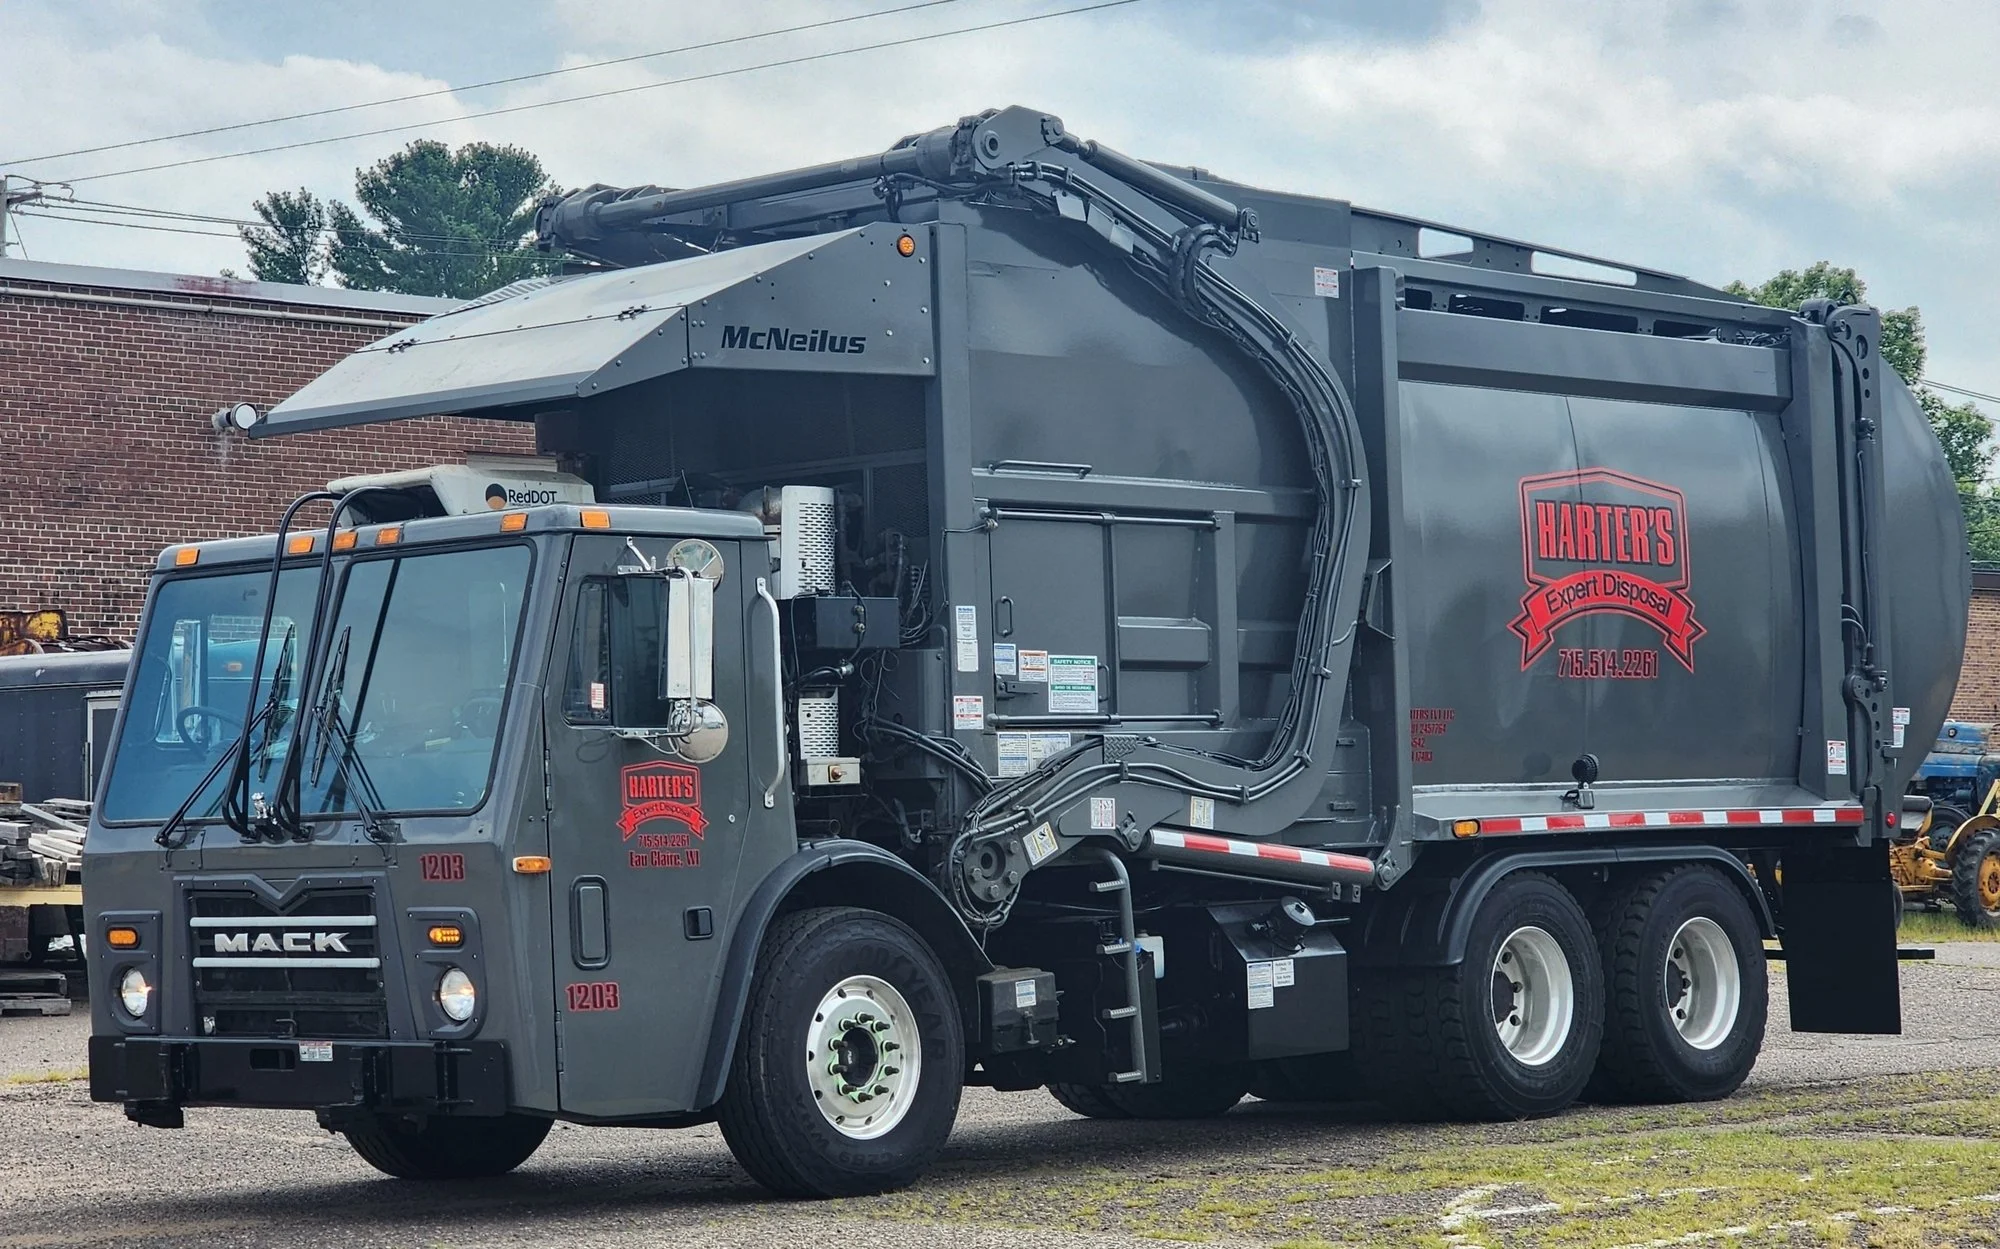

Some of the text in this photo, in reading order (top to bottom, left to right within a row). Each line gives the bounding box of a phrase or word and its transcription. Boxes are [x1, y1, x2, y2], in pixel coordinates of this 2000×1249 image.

[721, 325, 866, 354] McNeilus
[508, 489, 557, 504] RedDOT
[1535, 499, 1676, 567] HARTER'S
[1546, 573, 1673, 617] Expert Disposal
[1558, 649, 1659, 679] 715.514.2261
[629, 775, 694, 799] HARTER'S
[633, 802, 692, 819] Expert Disposal
[638, 834, 690, 849] 715.514.2261
[420, 854, 466, 881] 1203
[629, 849, 699, 868] Eau Claire, WI
[214, 932, 351, 953] MACK
[565, 982, 620, 1011] 1203
